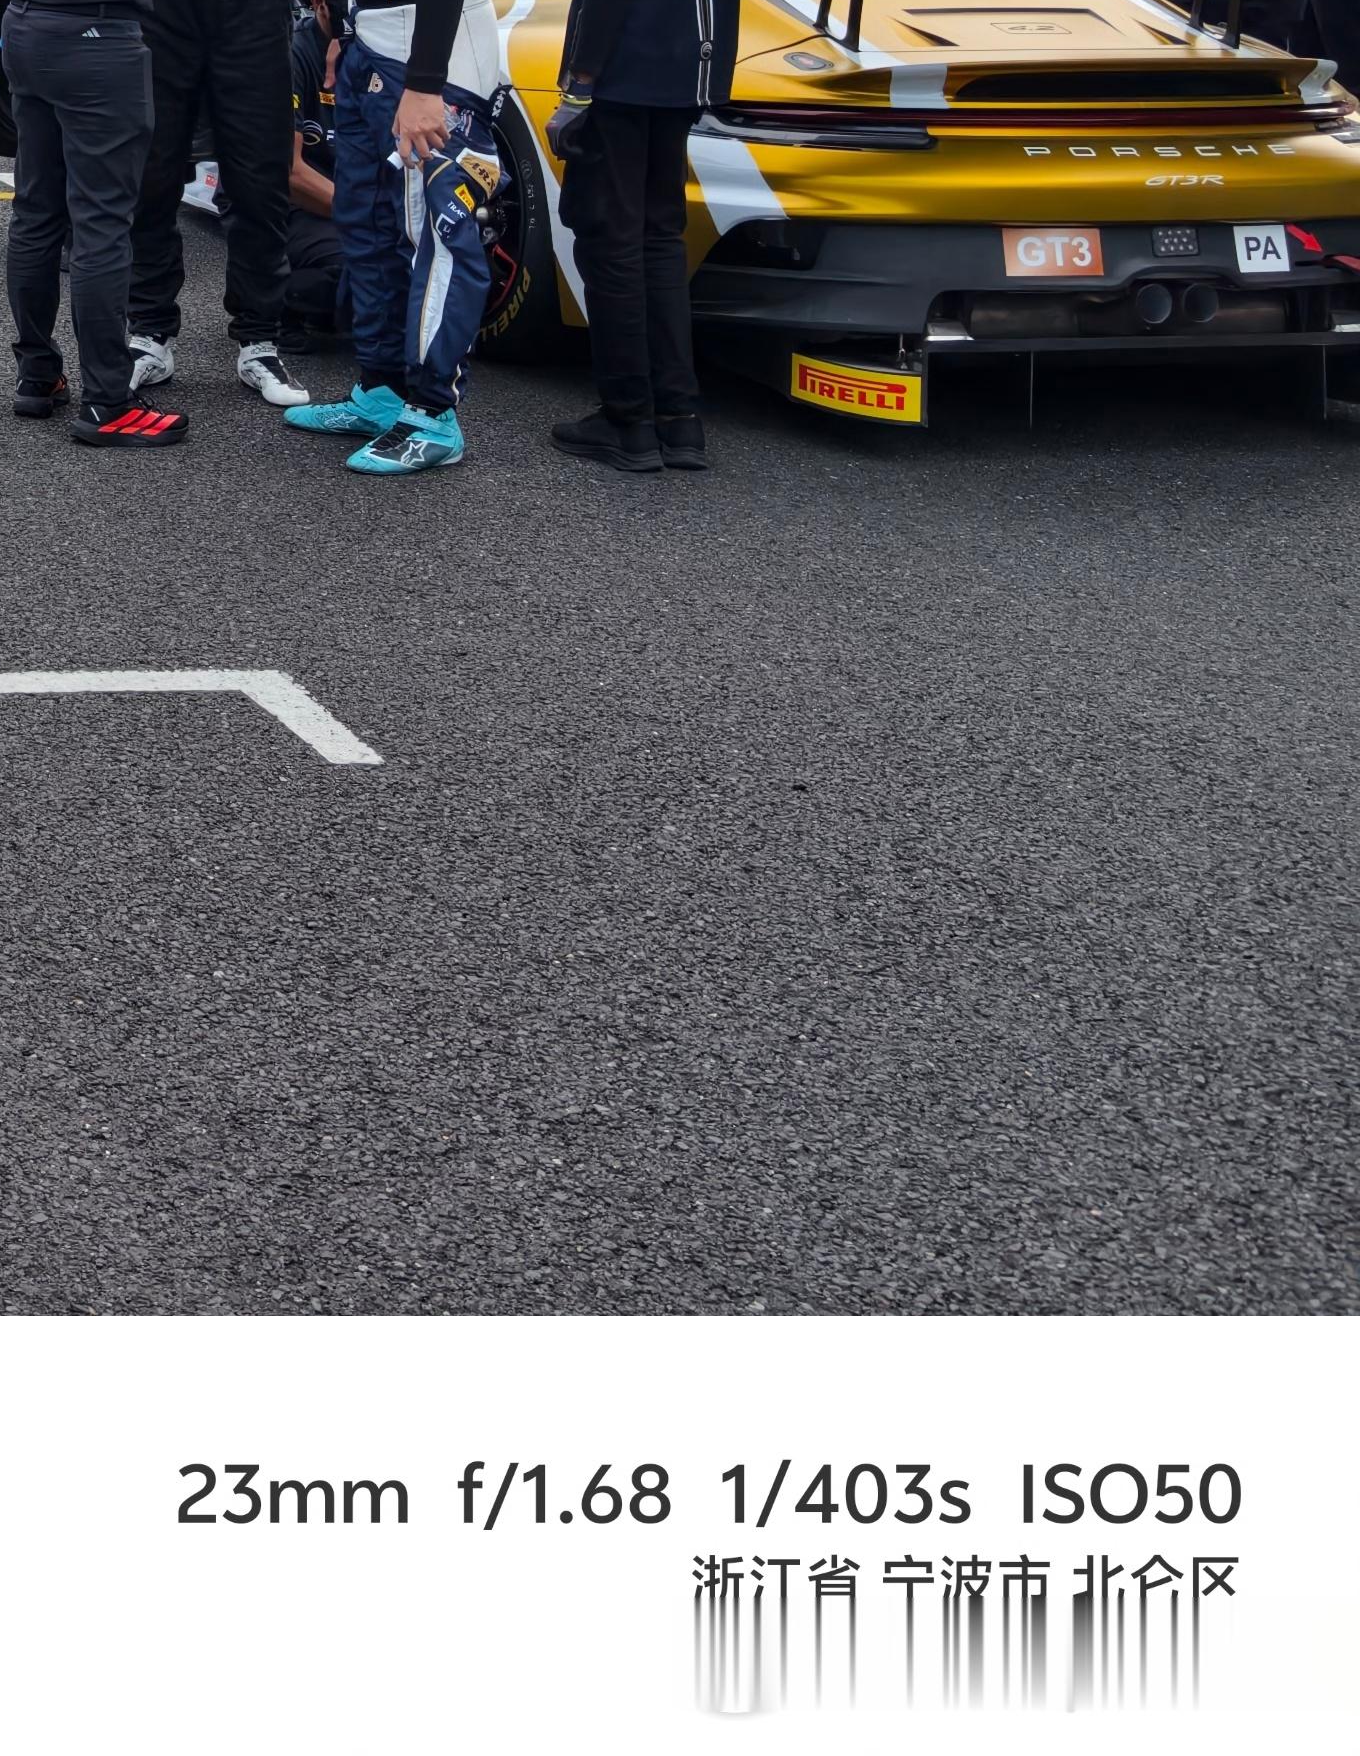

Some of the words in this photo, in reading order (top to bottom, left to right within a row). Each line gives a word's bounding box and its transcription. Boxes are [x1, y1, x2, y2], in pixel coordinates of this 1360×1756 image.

[1023, 144, 1296, 157] PORSCHE
[1016, 236, 1093, 268] GT3
[1244, 236, 1282, 262] PA
[799, 364, 907, 410] PIRELLI
